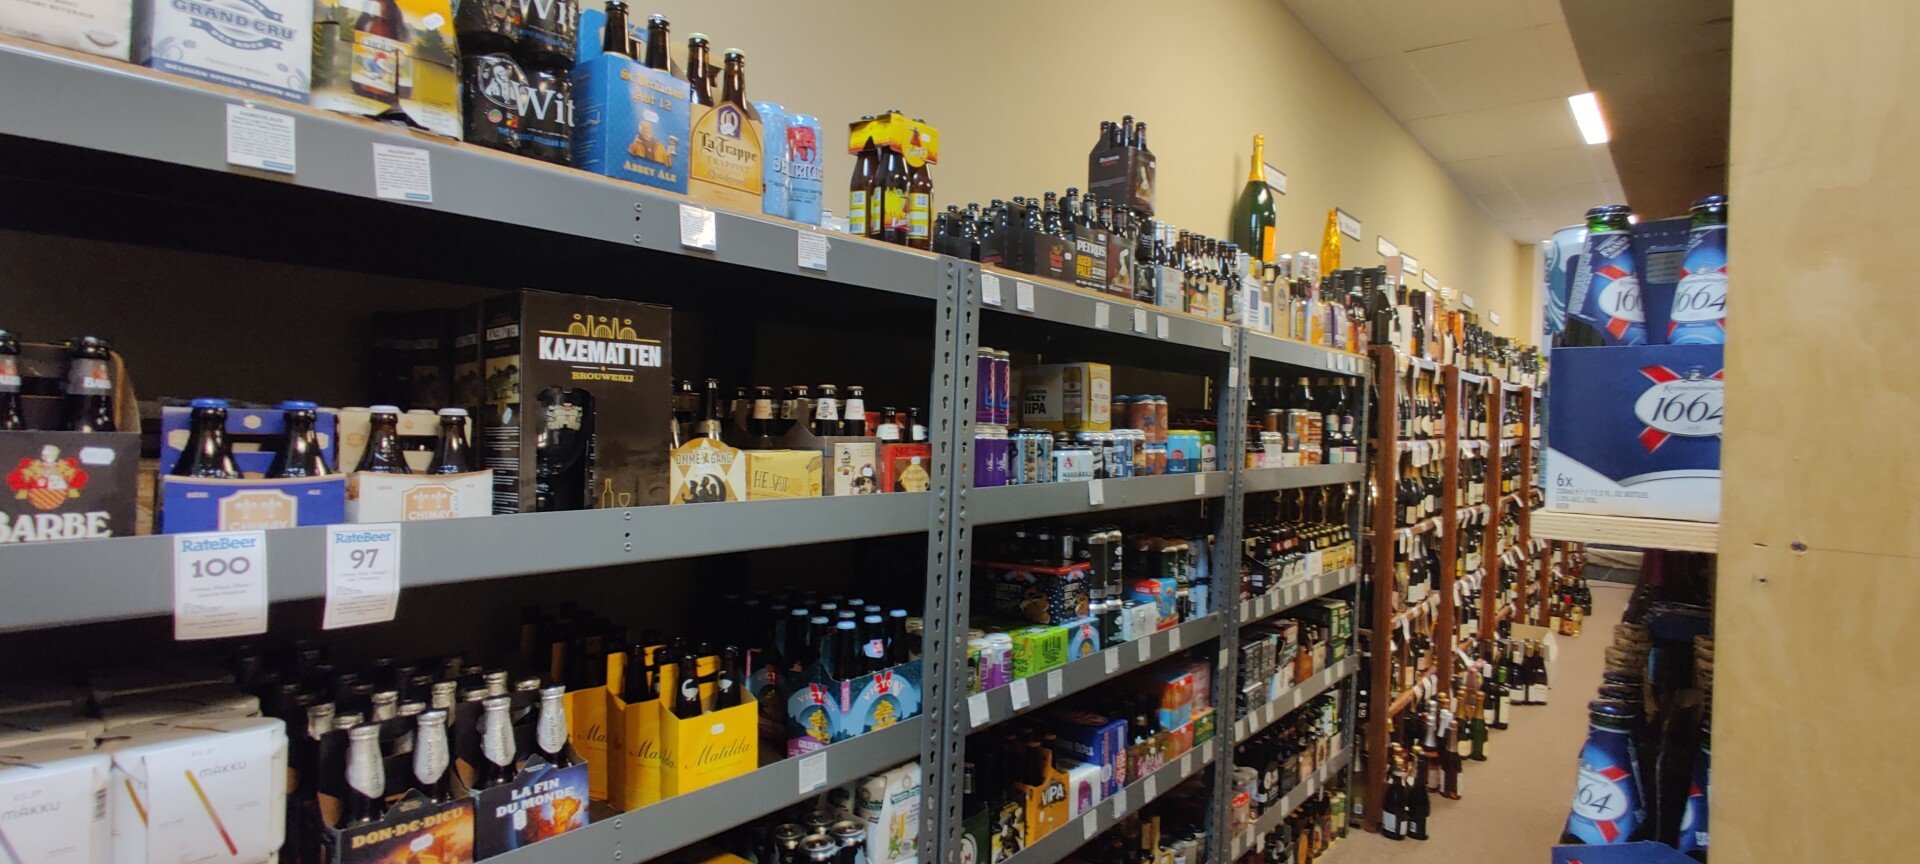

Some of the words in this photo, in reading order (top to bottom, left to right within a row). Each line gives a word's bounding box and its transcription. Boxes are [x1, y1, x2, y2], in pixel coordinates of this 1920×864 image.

[173, 1, 248, 26] GRAND
[254, 20, 296, 40] CRU
[510, 79, 576, 127] Wit
[658, 98, 671, 111] 12
[698, 131, 715, 152] La
[715, 136, 757, 162] Trappe
[705, 156, 750, 173] TRAPPIST
[1076, 239, 1106, 257] PETRUS
[538, 336, 662, 367] KAZEMATTEN
[571, 371, 634, 383] BROUWERIJ
[753, 470, 769, 488] HE
[1556, 473, 1573, 487] 6x
[182, 537, 256, 552] RateBeer
[335, 532, 391, 543] RateBeer
[191, 557, 250, 578] 100
[350, 548, 379, 569] 97
[685, 736, 753, 770] Matilda
[199, 761, 247, 778] MAKKU
[511, 786, 532, 801] LA
[534, 778, 560, 793] FIN
[1578, 783, 1614, 813] 64
[1, 802, 60, 821] MAKKU
[496, 802, 518, 818] DU
[521, 786, 574, 810] MONDE
